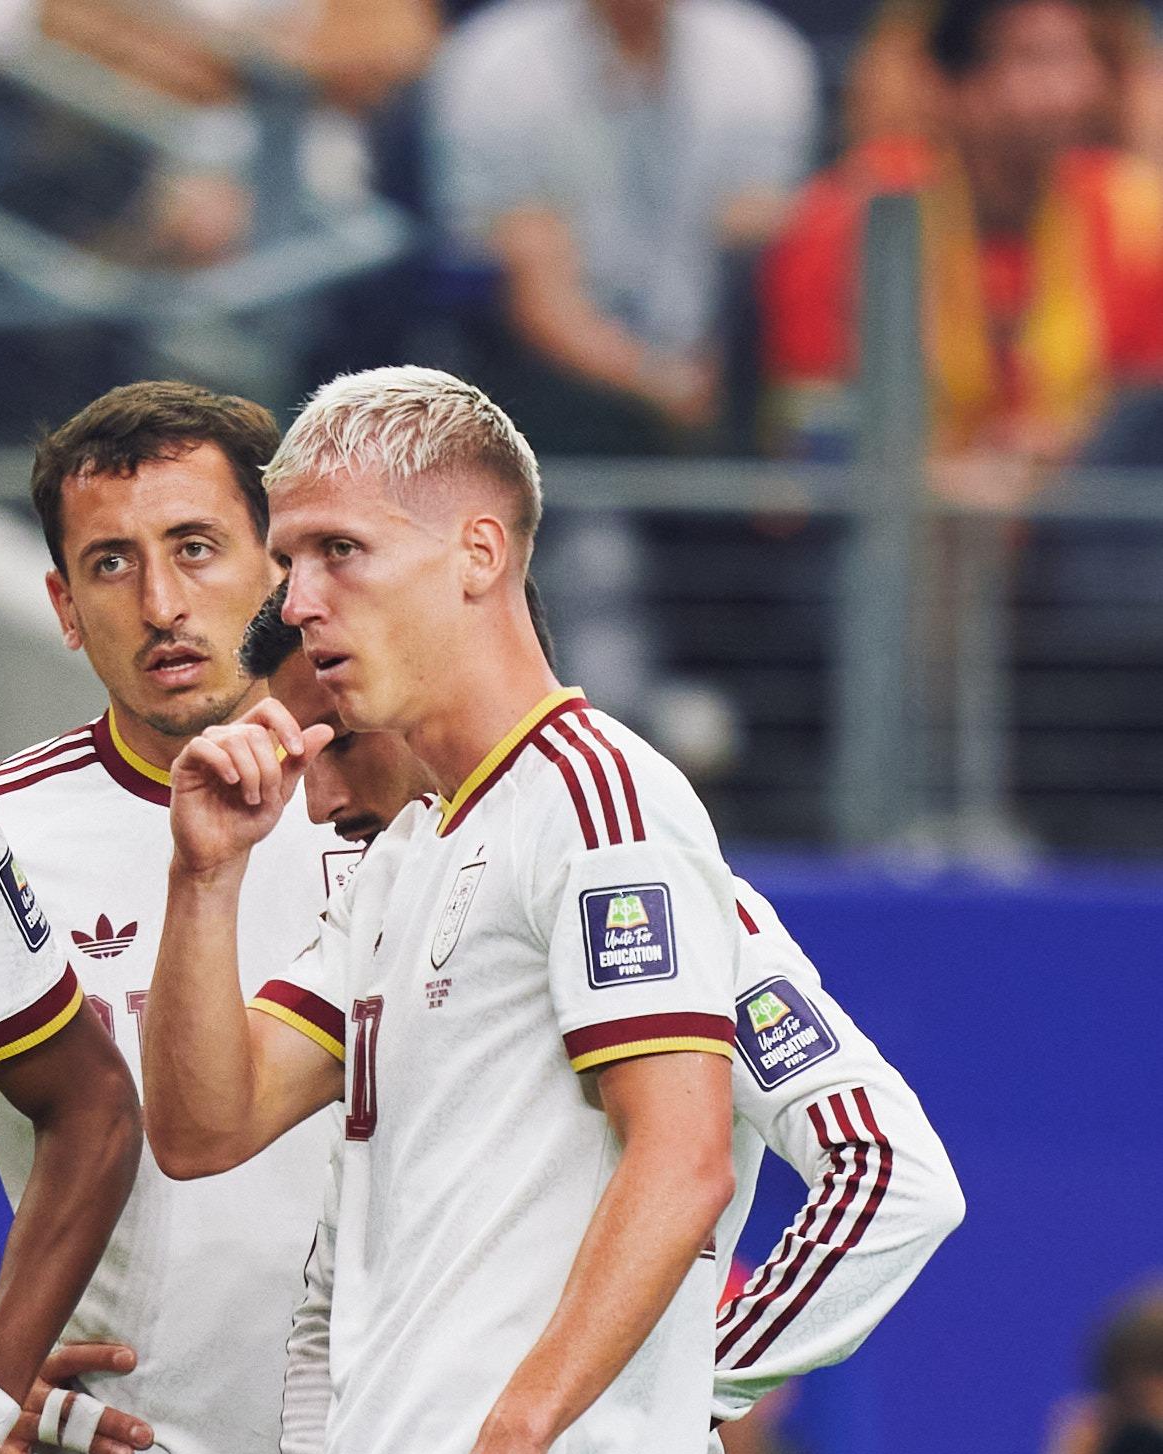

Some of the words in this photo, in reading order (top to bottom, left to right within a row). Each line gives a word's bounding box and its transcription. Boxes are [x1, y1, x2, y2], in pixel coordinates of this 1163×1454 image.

[634, 927, 653, 945] For
[599, 945, 662, 967] EDUCATION
[619, 964, 643, 976] FIFA
[783, 1016, 801, 1035] For
[759, 1025, 819, 1070] EDUCATION
[783, 1052, 809, 1068] FIFA
